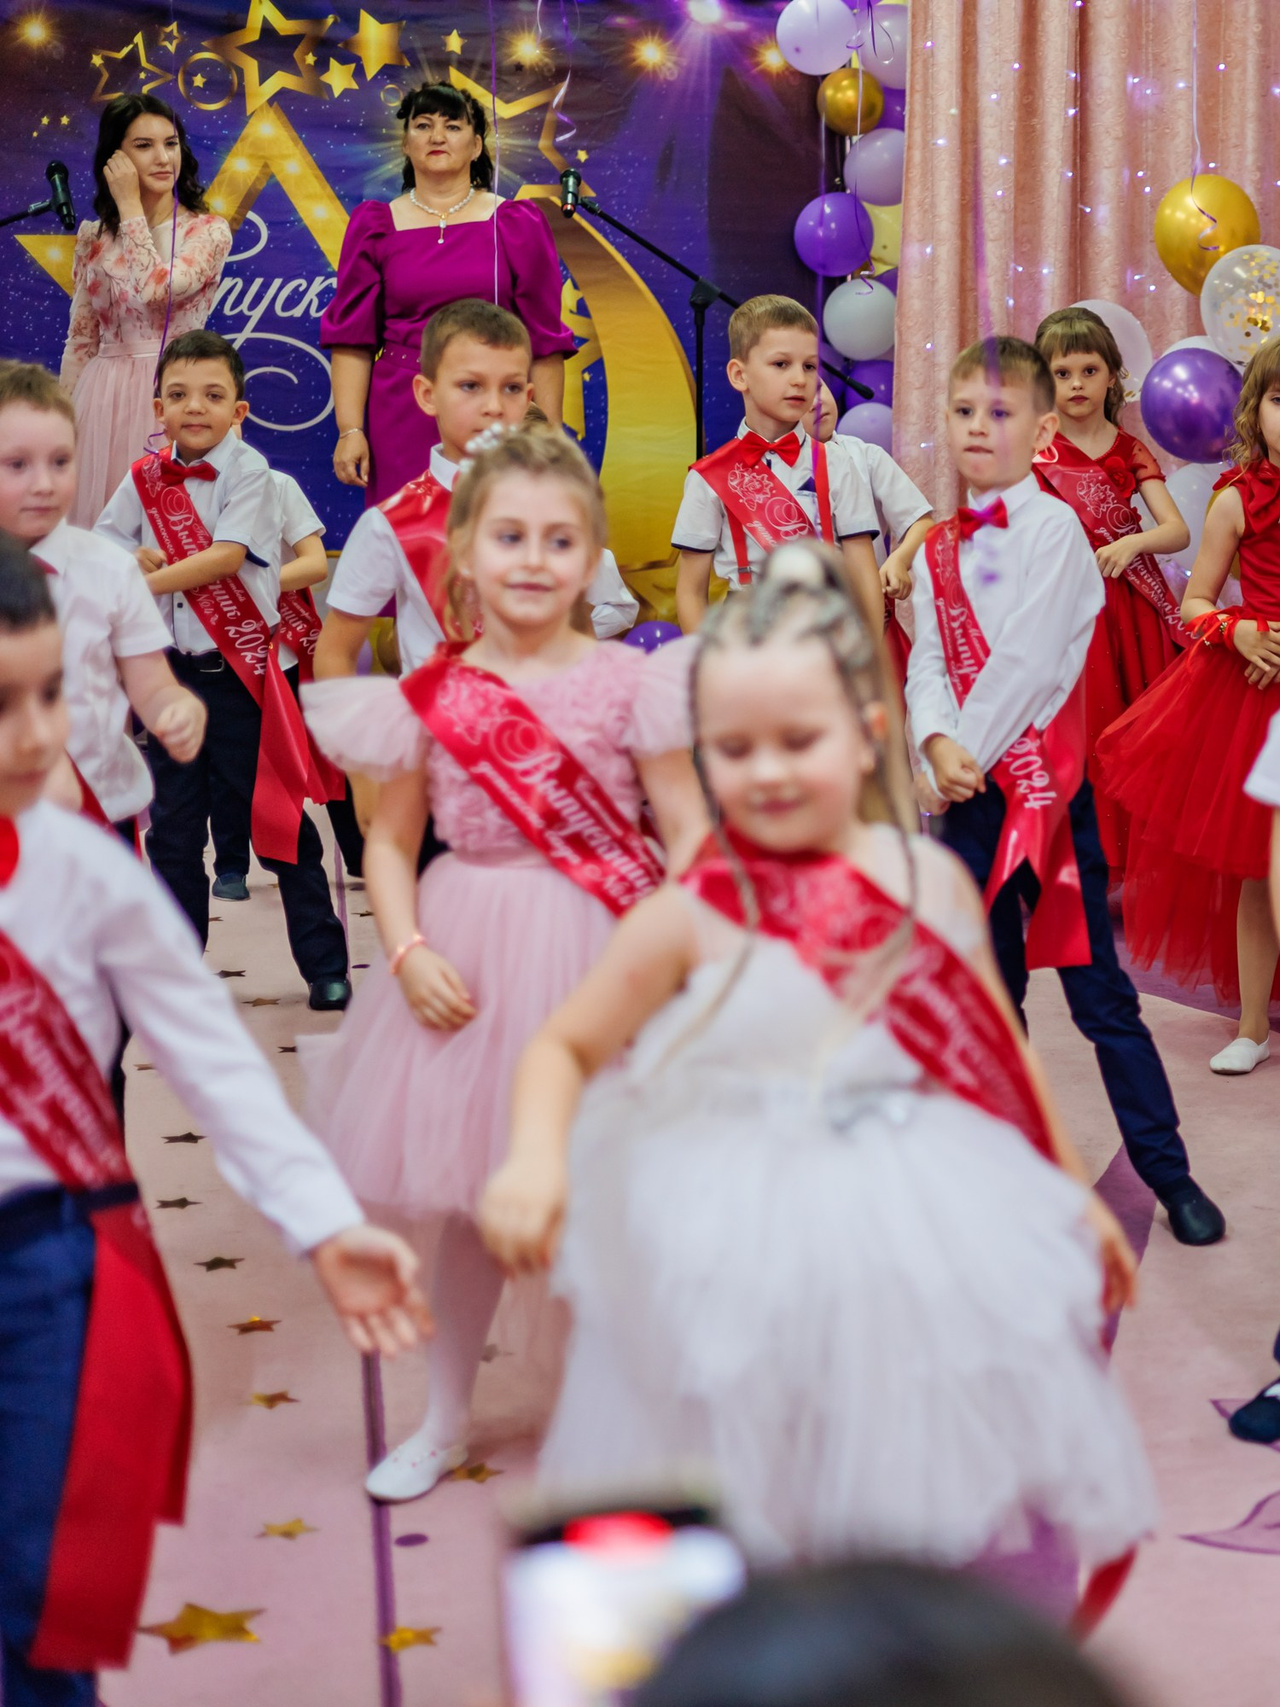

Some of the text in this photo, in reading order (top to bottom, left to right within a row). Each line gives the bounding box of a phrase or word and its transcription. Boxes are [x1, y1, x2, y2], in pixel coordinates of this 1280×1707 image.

[148, 507, 175, 556] детского
[224, 619, 270, 676] 2024
[949, 660, 964, 692] сада
[1001, 736, 1058, 810] 2024
